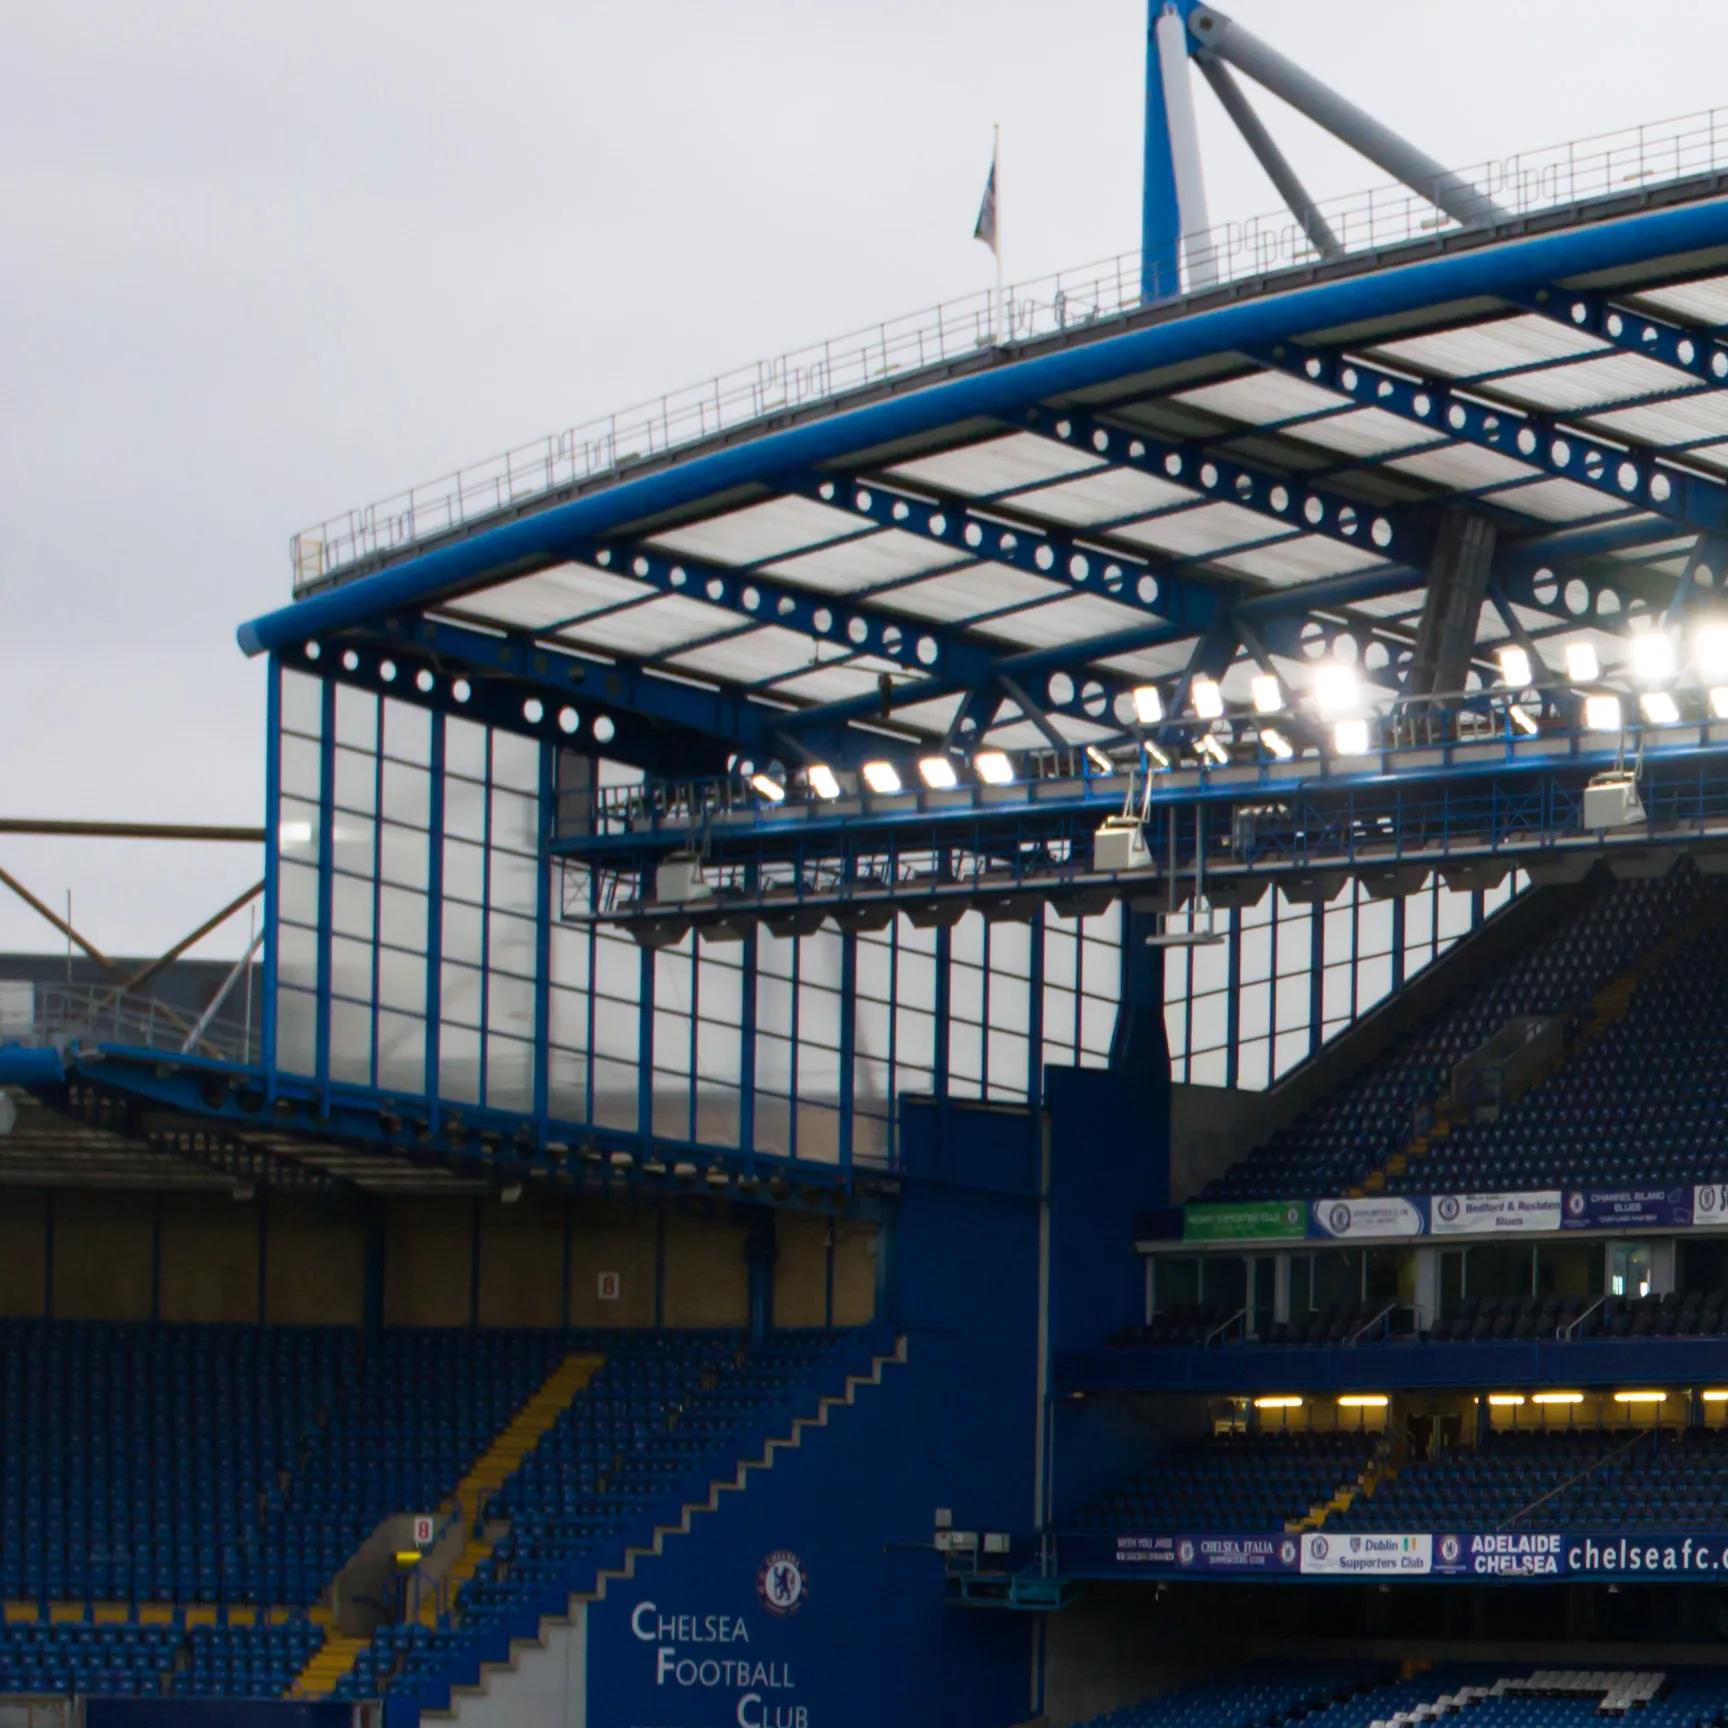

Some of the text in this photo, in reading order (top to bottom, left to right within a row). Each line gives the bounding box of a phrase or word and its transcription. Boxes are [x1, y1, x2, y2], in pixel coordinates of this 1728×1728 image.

[1507, 1202, 1514, 1211] &
[1614, 1203, 1641, 1212] BLUES
[1201, 1540, 1274, 1553] CHELSEA ITALIA
[1365, 1539, 1398, 1551] Dublin
[1471, 1536, 1561, 1553] ADELAIDE
[1340, 1557, 1424, 1571] Supporters Club
[1474, 1556, 1558, 1574] CHELSEA
